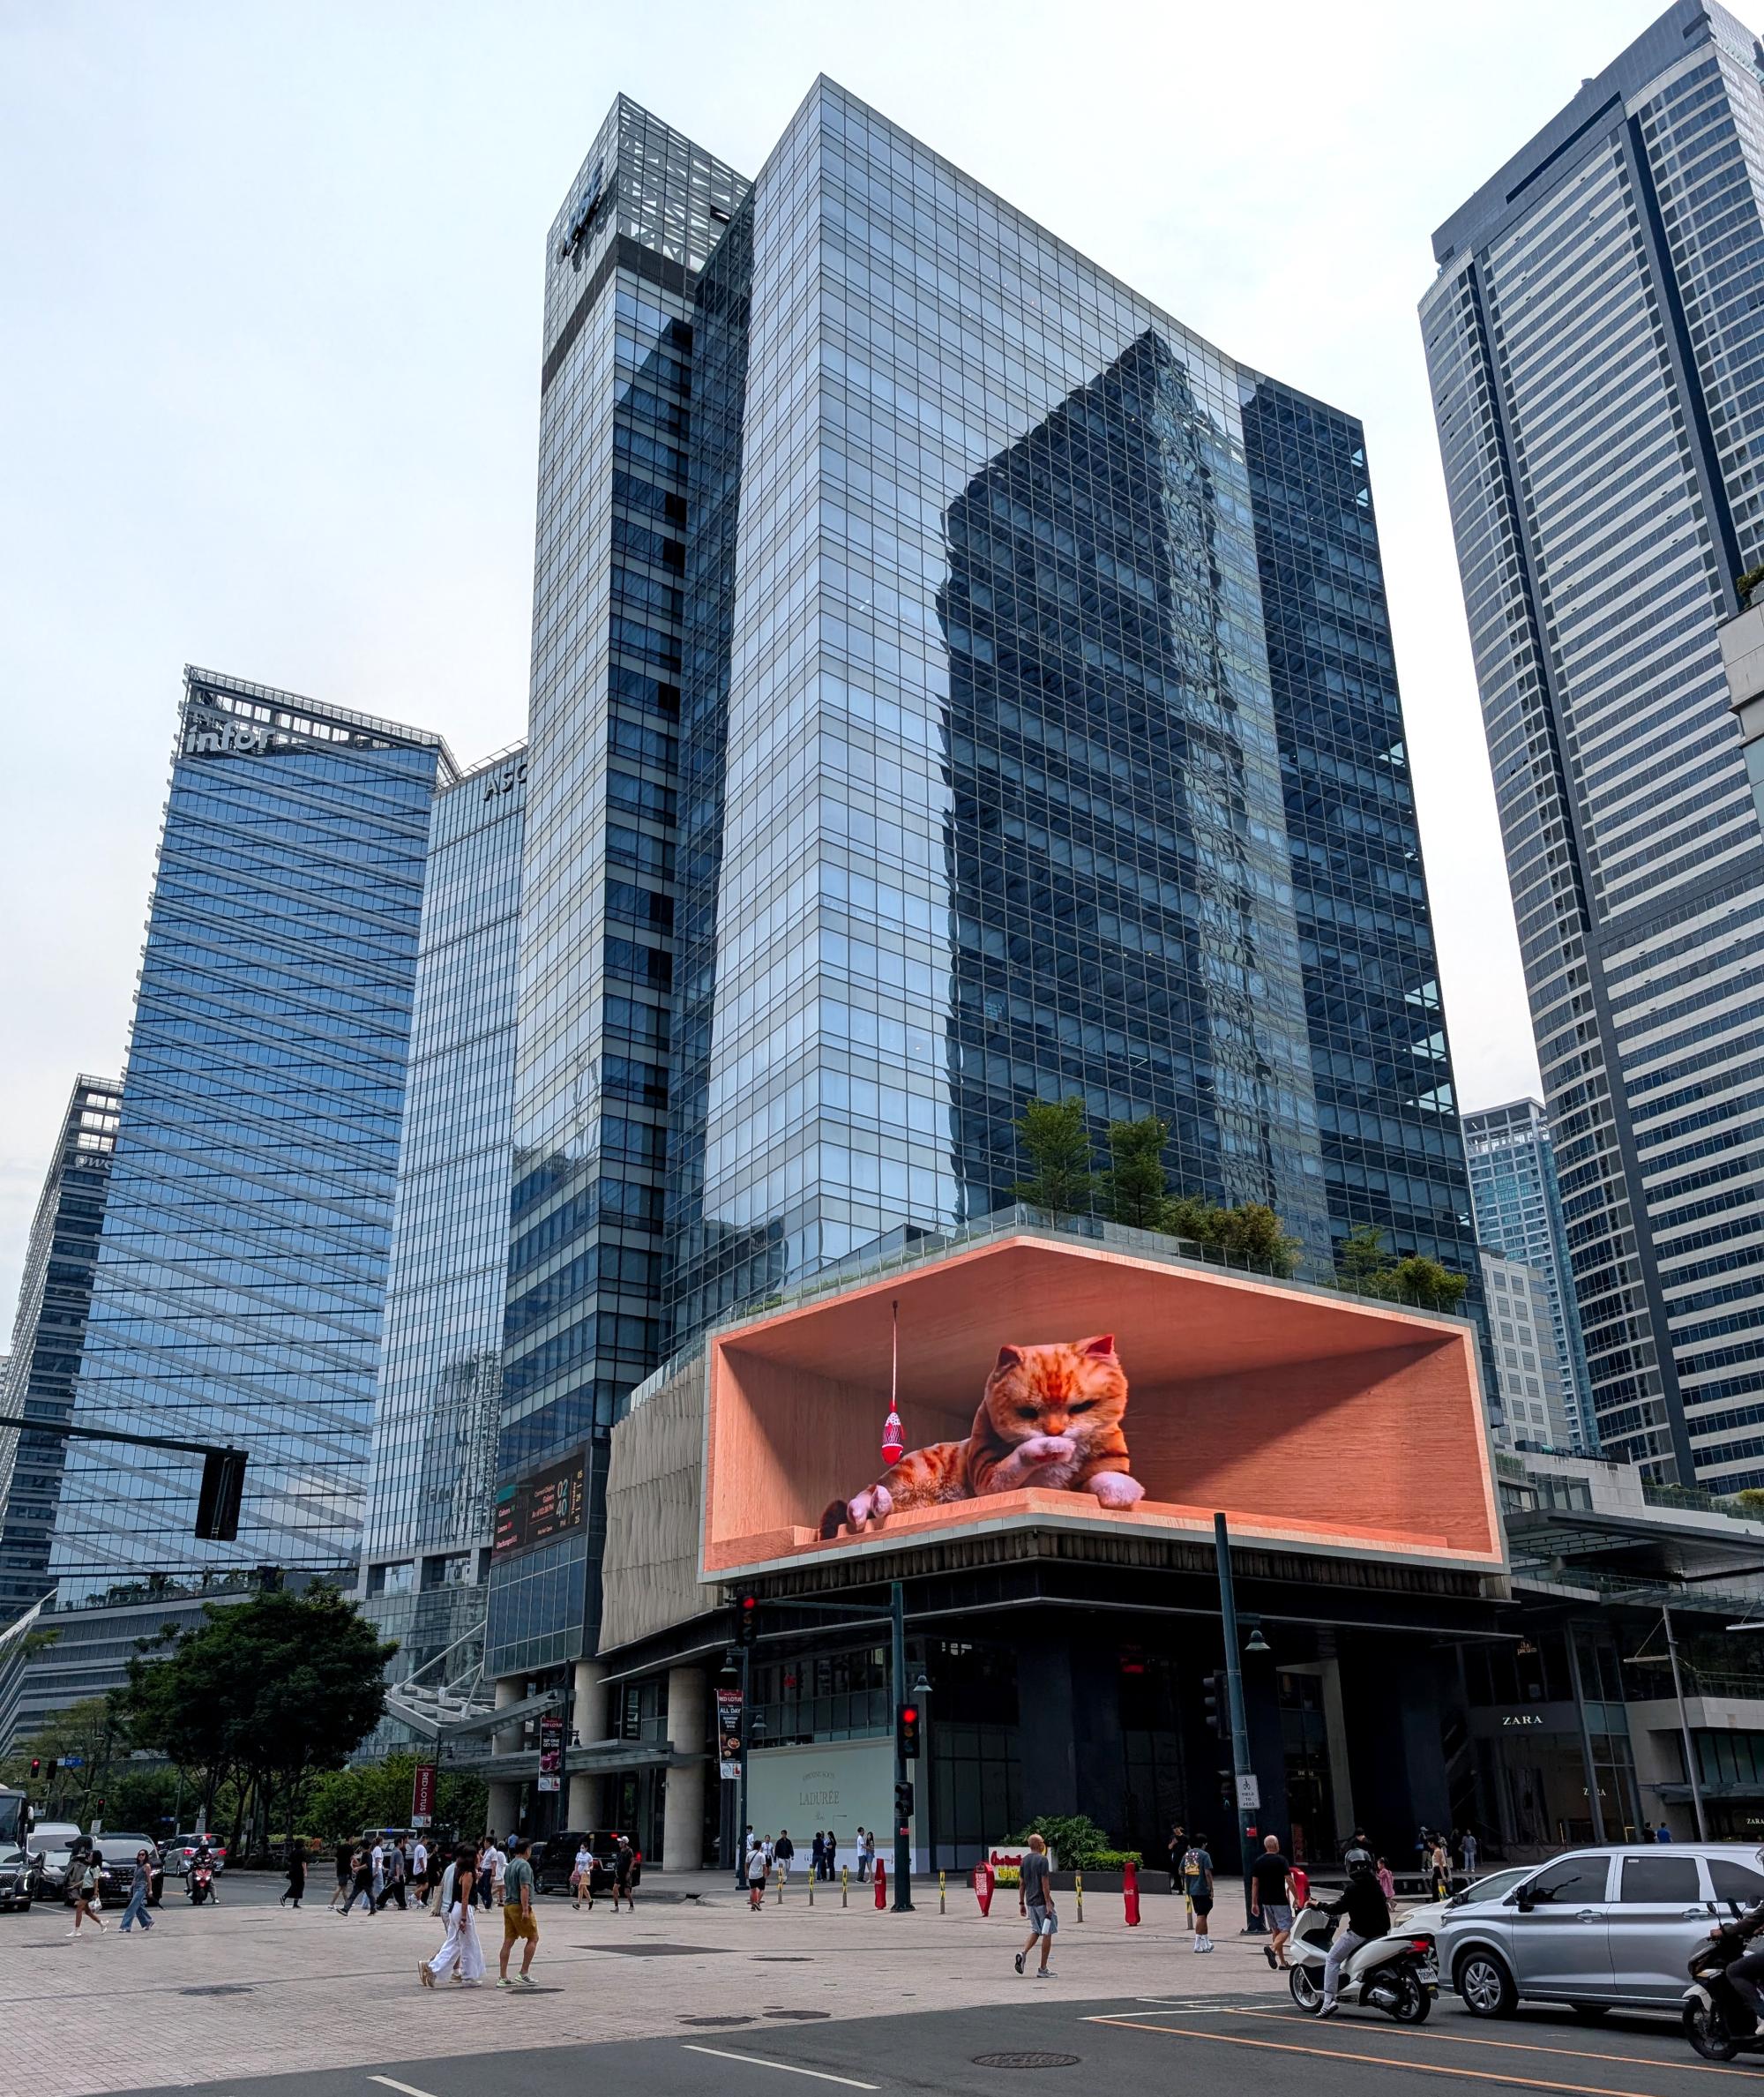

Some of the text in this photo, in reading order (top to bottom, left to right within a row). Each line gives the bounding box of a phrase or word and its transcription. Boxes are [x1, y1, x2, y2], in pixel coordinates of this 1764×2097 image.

[186, 721, 276, 753] infor
[557, 1478, 569, 1500] 02
[556, 1498, 568, 1517] 40
[1502, 1715, 1544, 1726] ZARA
[799, 1790, 840, 1806] LADURÉE
[1582, 1787, 1606, 1796] ZA
